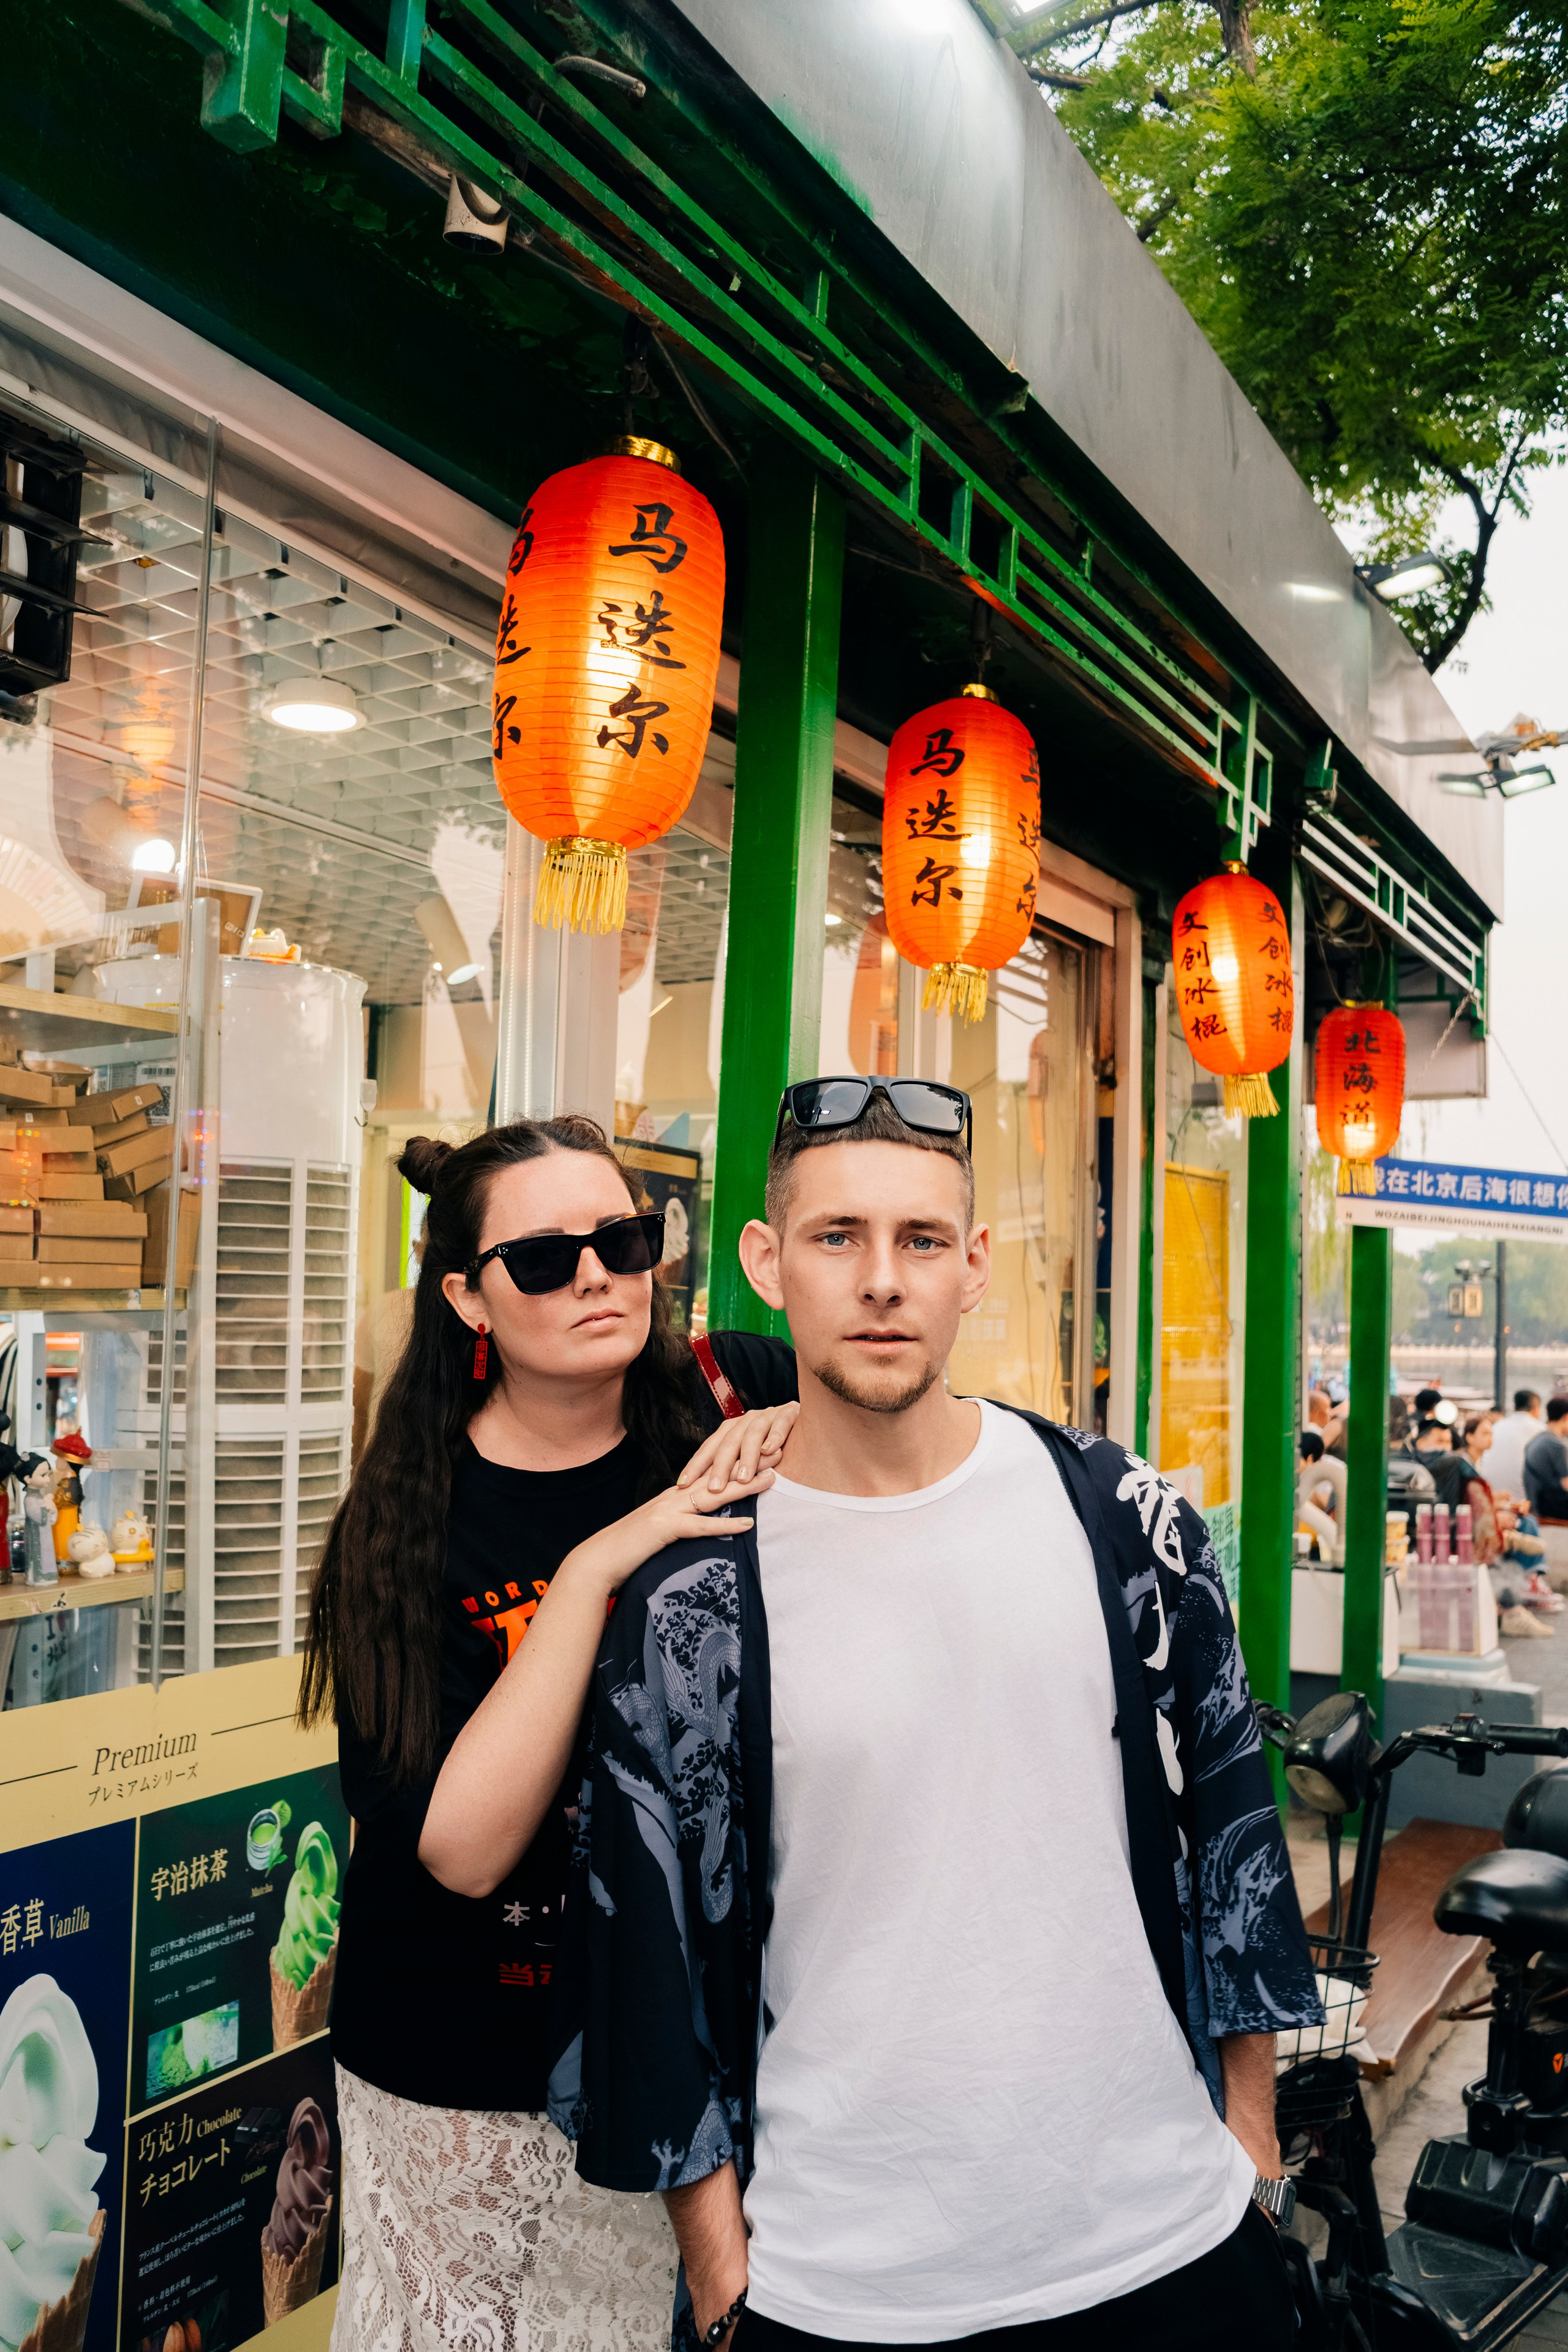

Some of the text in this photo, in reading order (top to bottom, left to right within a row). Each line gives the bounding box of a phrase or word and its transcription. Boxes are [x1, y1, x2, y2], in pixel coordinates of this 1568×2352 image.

[597, 502, 688, 759] 马迭尔
[905, 728, 972, 907] 马迭尔
[91, 1732, 197, 1776] Premium
[88, 1762, 199, 1807] プレミアムシリーズ
[151, 1848, 229, 1901] 宇治抹茶
[0, 1898, 90, 1956] 香草 Vanilla
[138, 2106, 243, 2162] 巧克力 Chocolate
[140, 2138, 231, 2207] チョコレート
[240, 2163, 268, 2185] Chocolate
